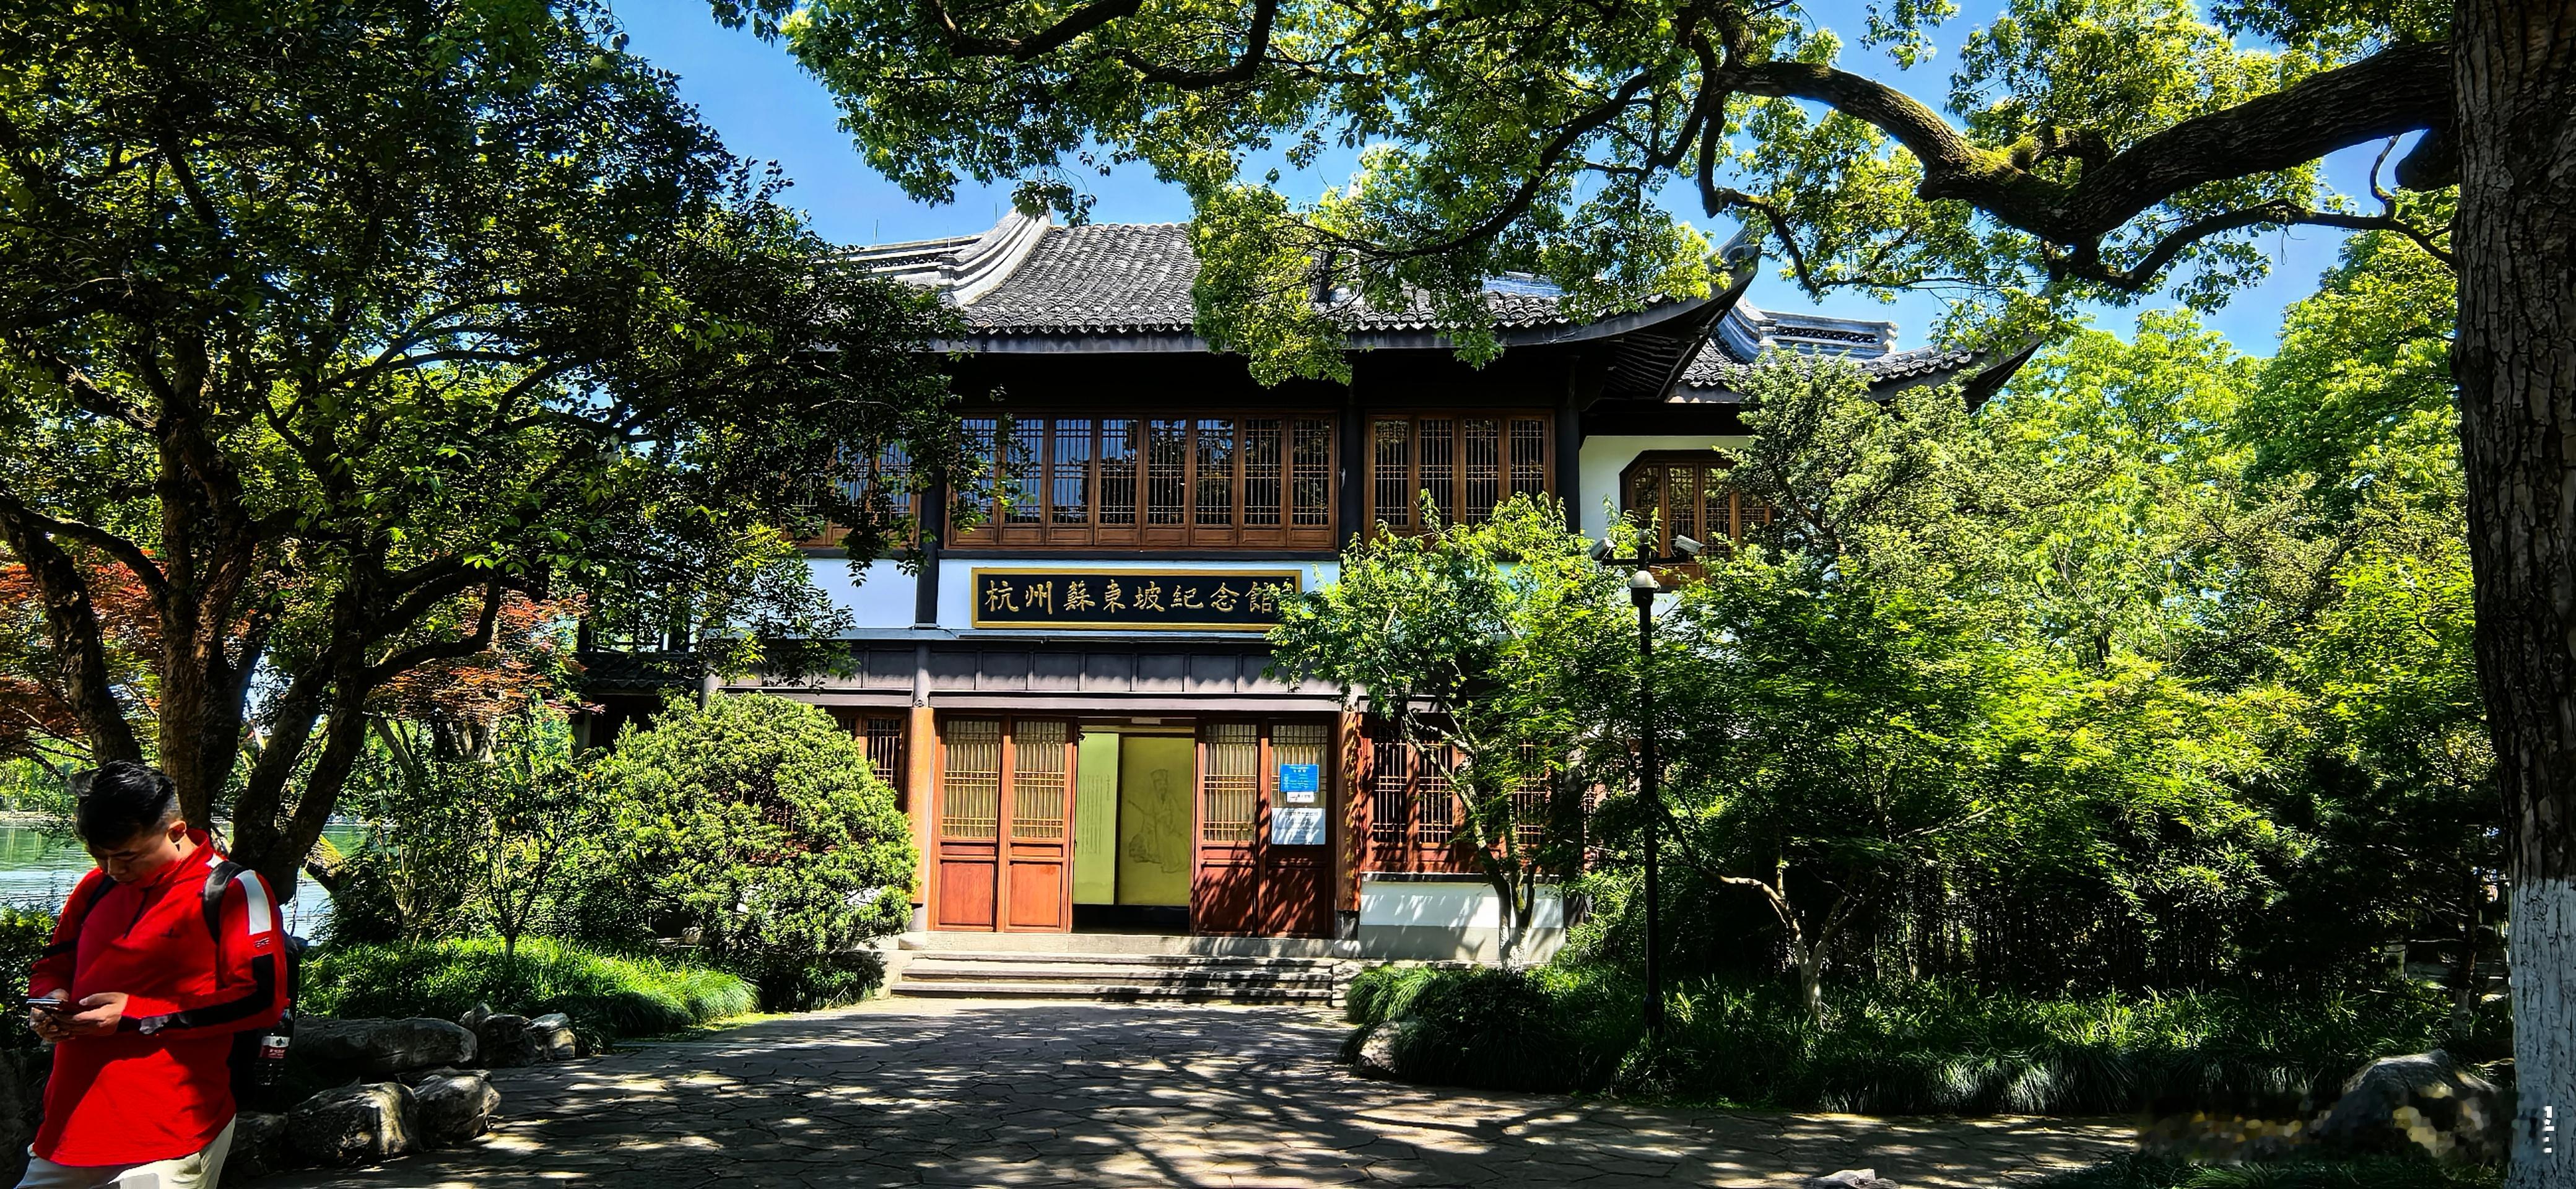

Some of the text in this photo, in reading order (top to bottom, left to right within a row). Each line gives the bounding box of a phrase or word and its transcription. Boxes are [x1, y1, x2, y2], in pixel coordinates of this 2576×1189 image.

[984, 579, 1276, 614] 杭州蘇東坡紀念館
